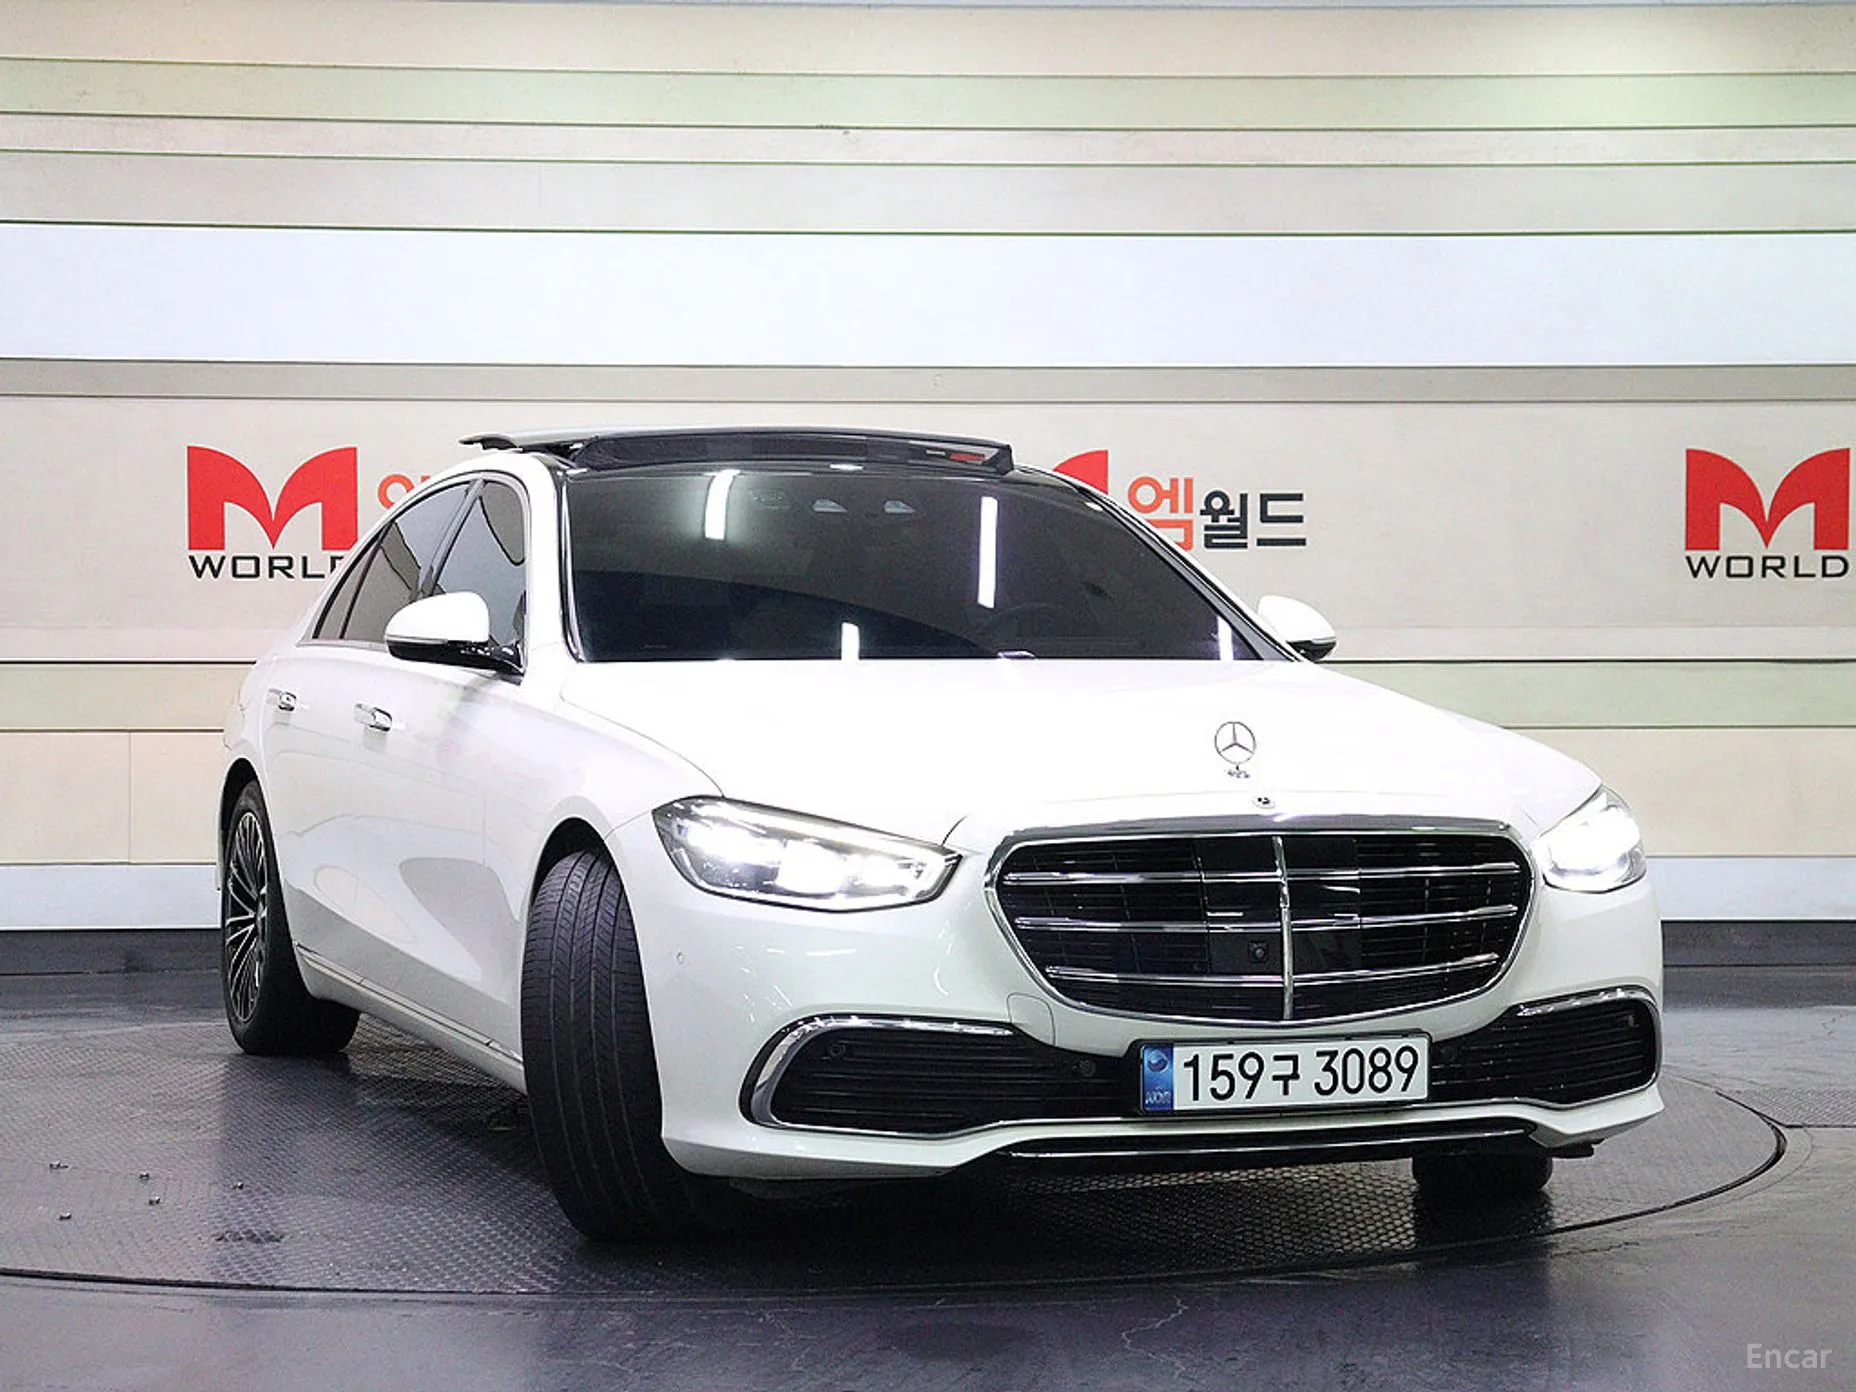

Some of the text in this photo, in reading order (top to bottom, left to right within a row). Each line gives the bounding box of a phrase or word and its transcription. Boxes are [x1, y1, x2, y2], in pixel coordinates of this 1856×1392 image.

[1128, 476, 1306, 551] 엠월드
[1685, 555, 1849, 578] WORLD
[1183, 1045, 1419, 1101] 159구 3089
